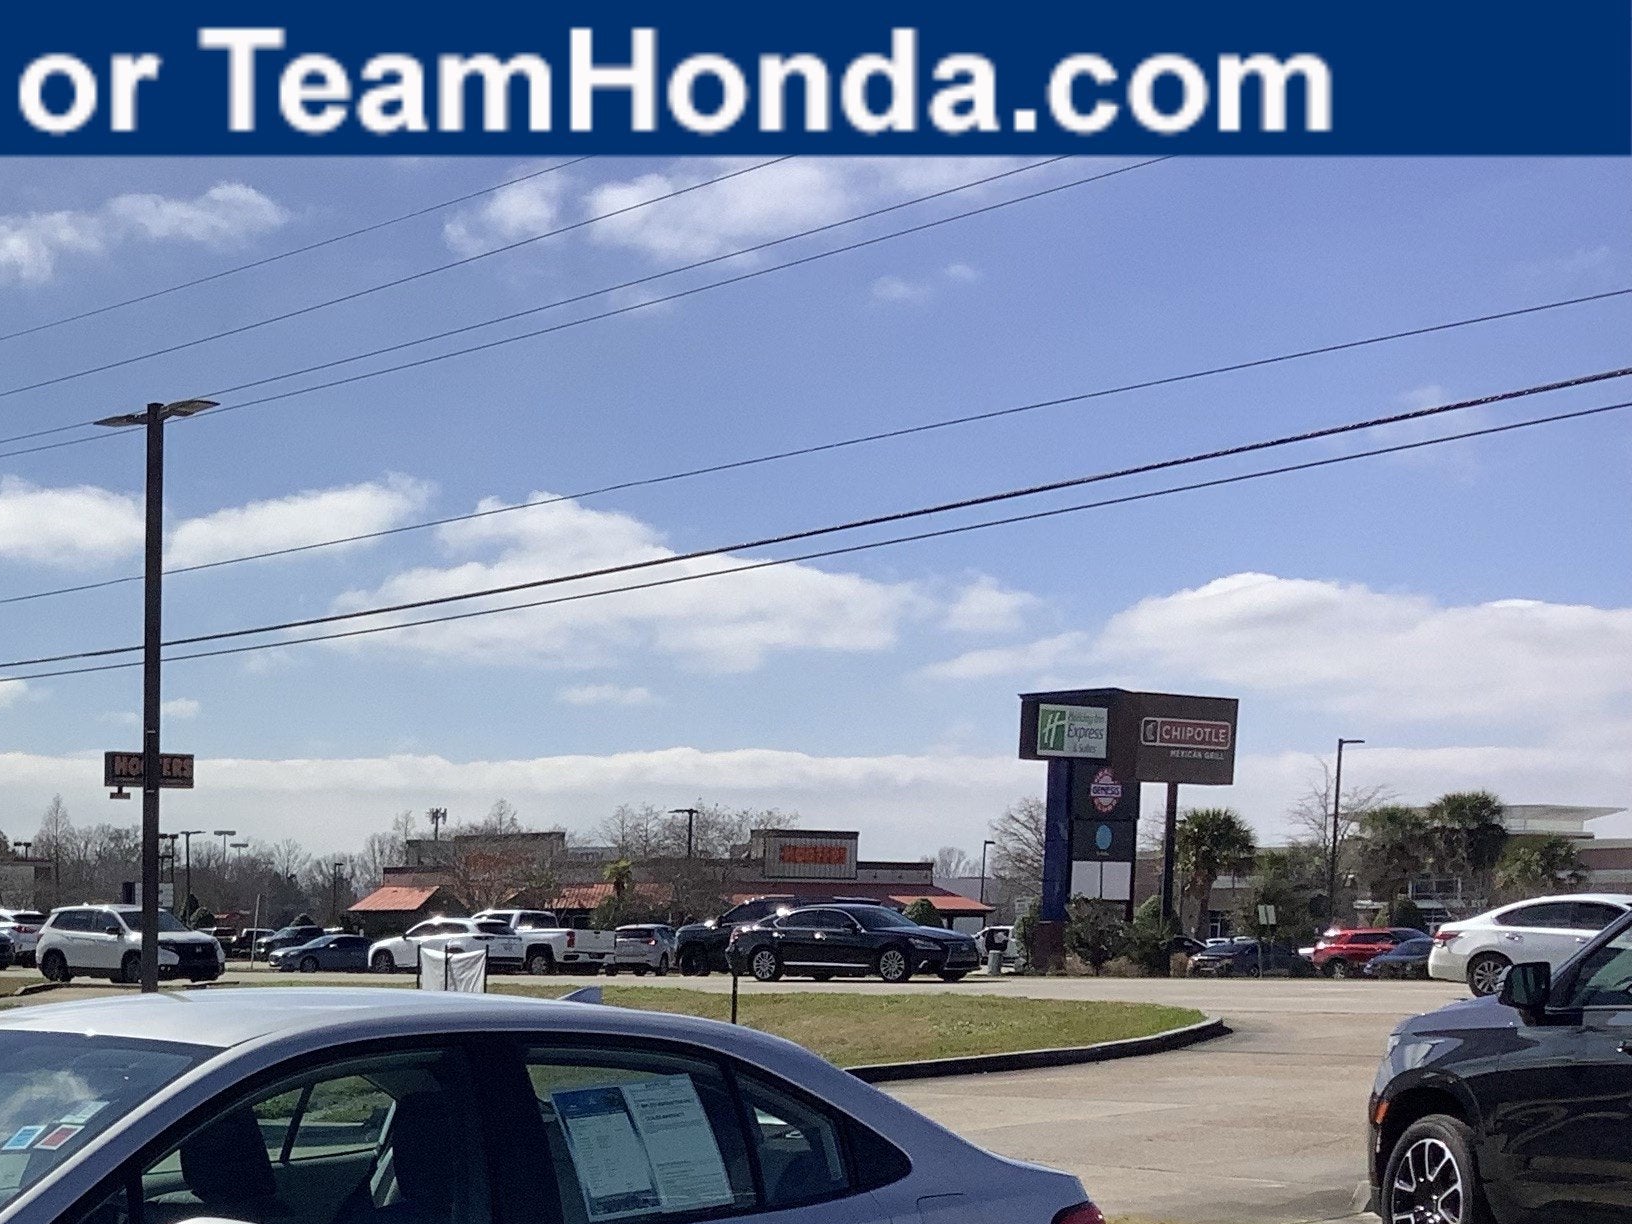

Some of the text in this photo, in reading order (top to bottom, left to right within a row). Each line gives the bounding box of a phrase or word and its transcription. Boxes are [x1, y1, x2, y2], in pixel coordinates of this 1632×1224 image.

[1067, 723, 1105, 742] Express
[1161, 725, 1227, 743] CHIPOTLE
[1170, 749, 1203, 760] MEXICAN
[114, 755, 193, 779] HOERS
